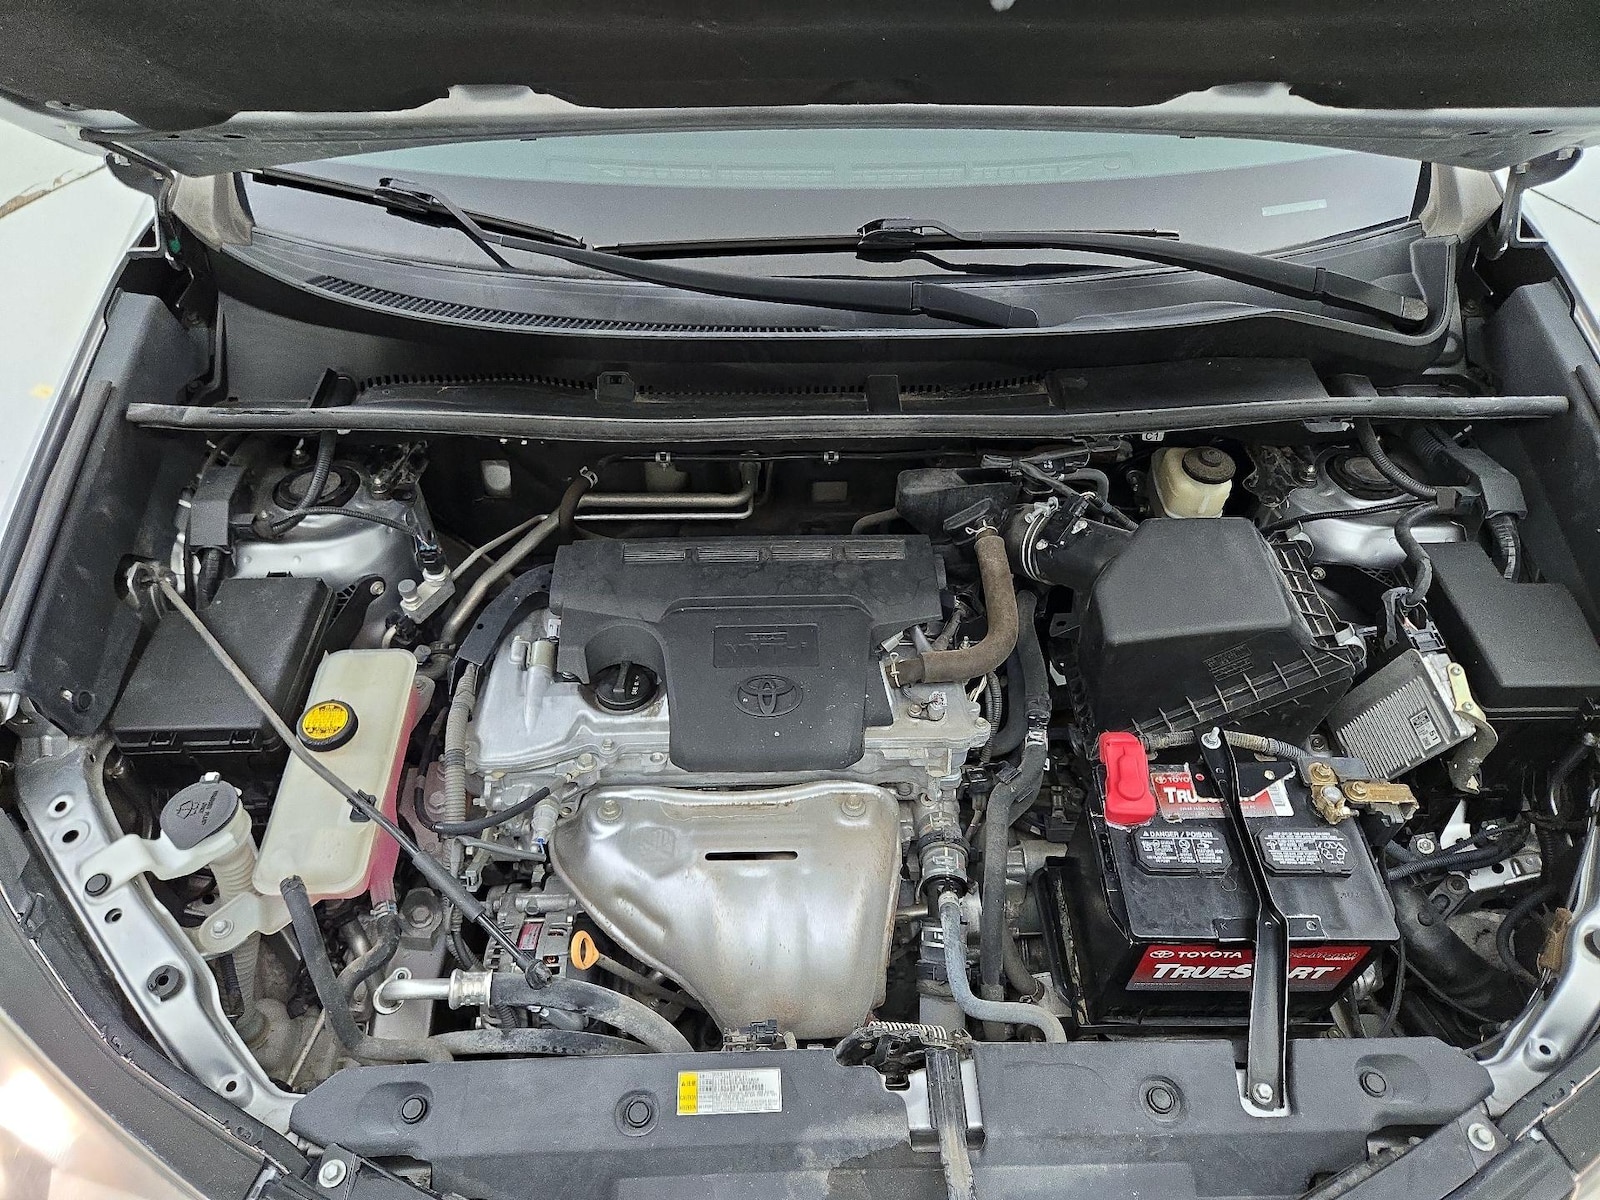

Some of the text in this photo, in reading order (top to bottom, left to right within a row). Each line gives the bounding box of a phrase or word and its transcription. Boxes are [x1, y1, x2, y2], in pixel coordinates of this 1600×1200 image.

[1145, 432, 1158, 440] C1
[1177, 951, 1242, 959] TOYOTA
[1152, 963, 1335, 980] TRUESRT
